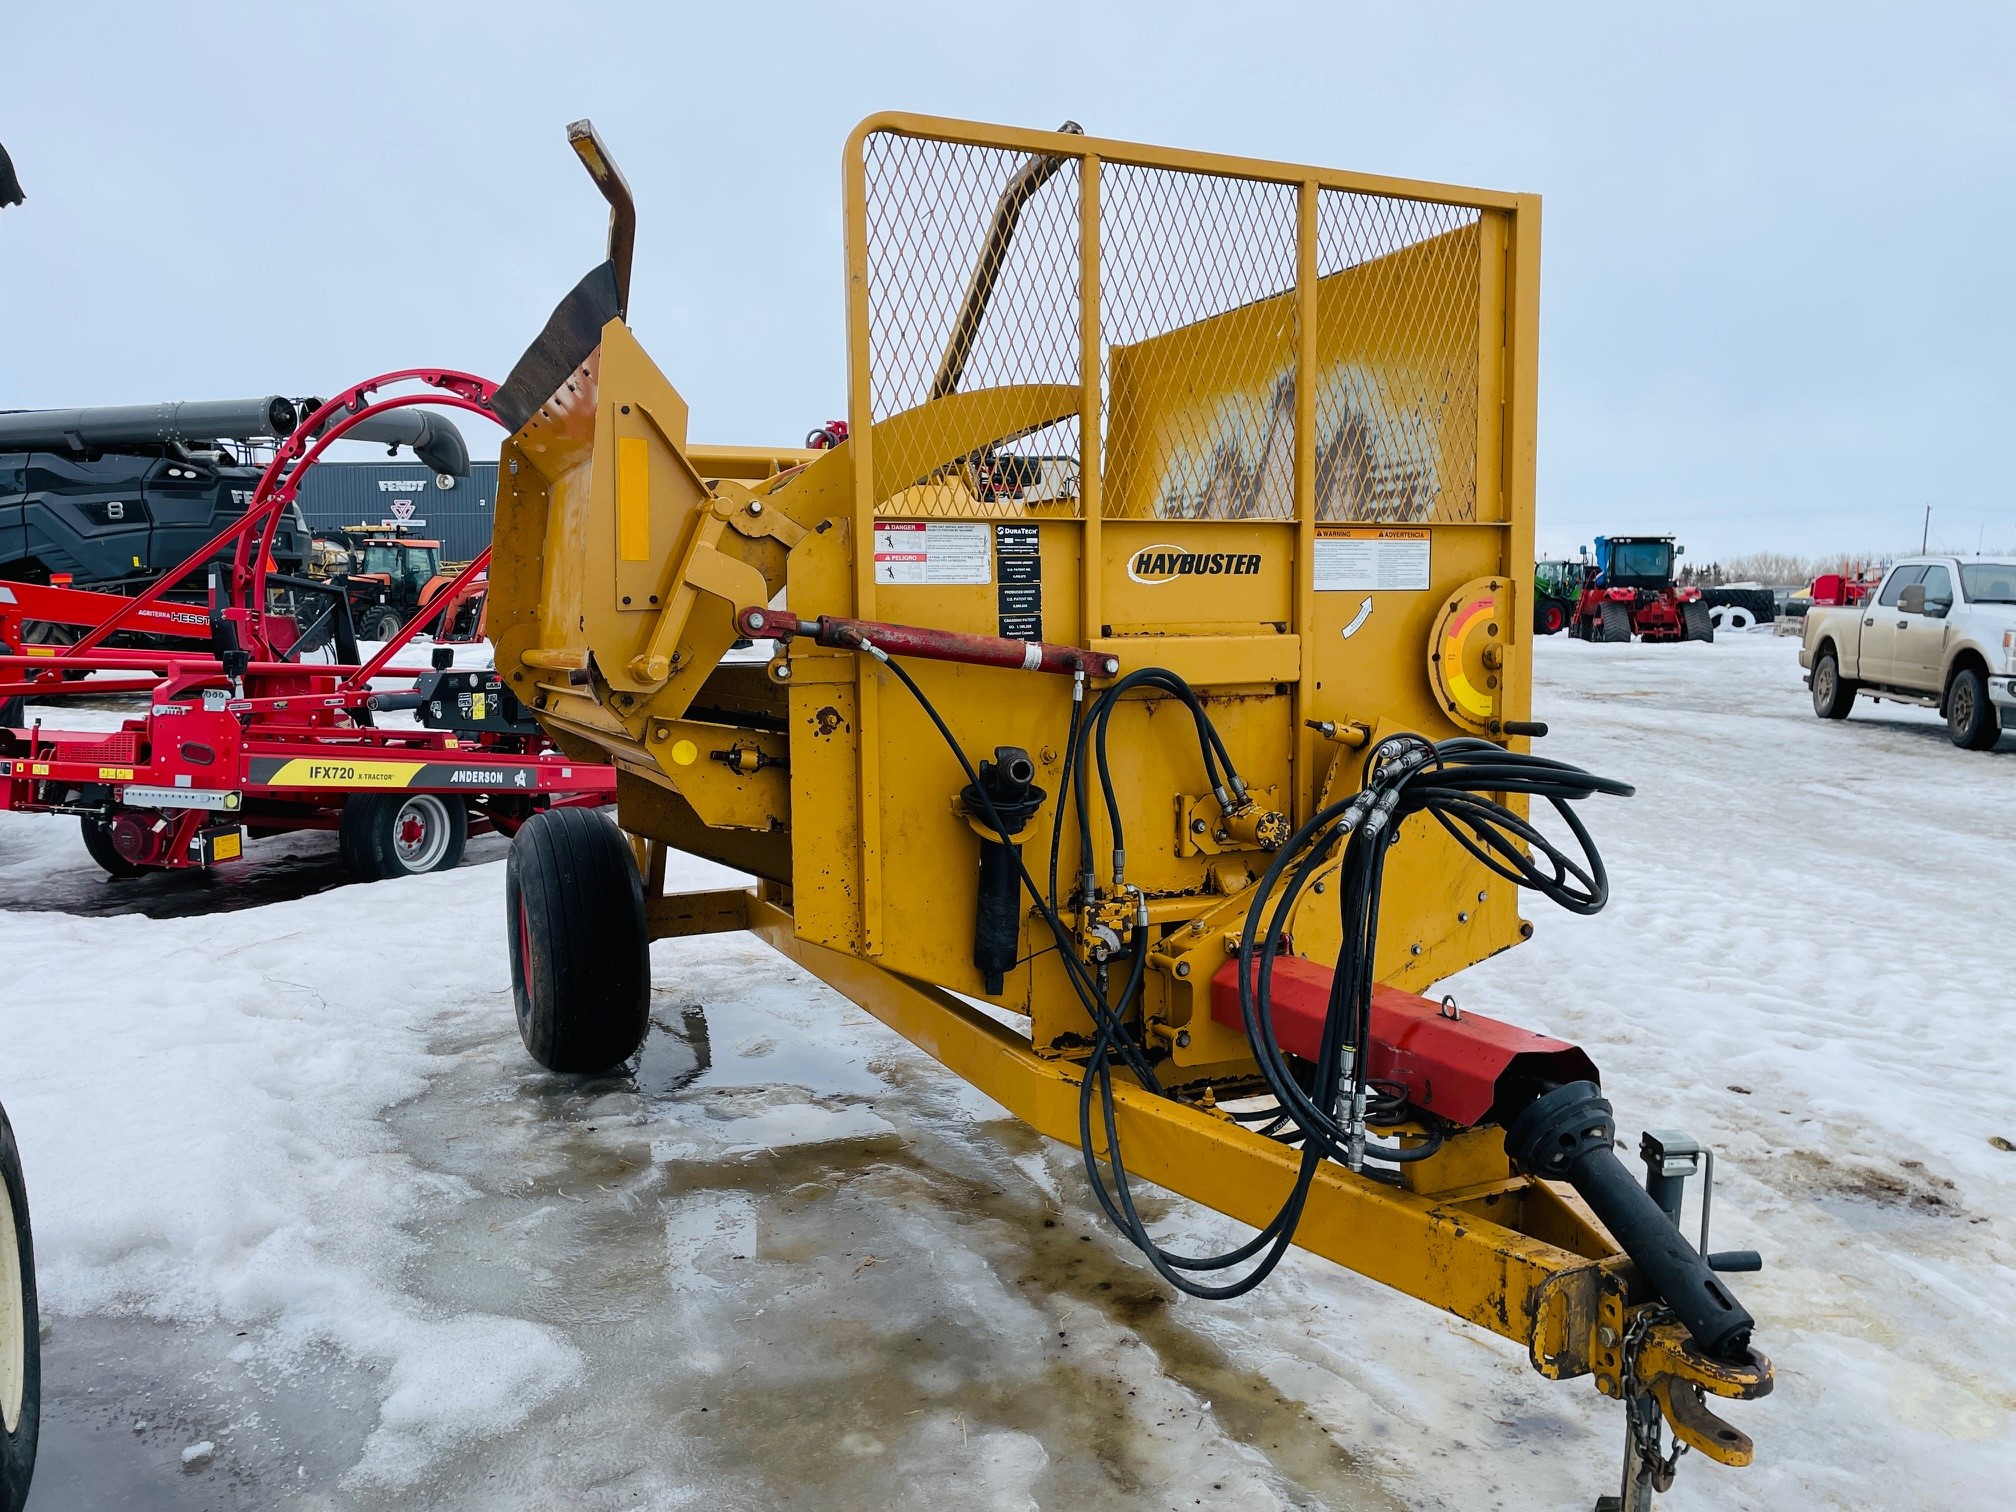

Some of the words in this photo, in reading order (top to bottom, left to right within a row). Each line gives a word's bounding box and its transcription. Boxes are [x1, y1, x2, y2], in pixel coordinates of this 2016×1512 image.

[378, 480, 427, 492] FENDT
[107, 501, 124, 519] 8
[1135, 553, 1262, 575] HAYBUSTER
[138, 609, 170, 619] AGRITERRA
[309, 766, 355, 780] IFX720
[450, 770, 503, 784] ANDERSON
